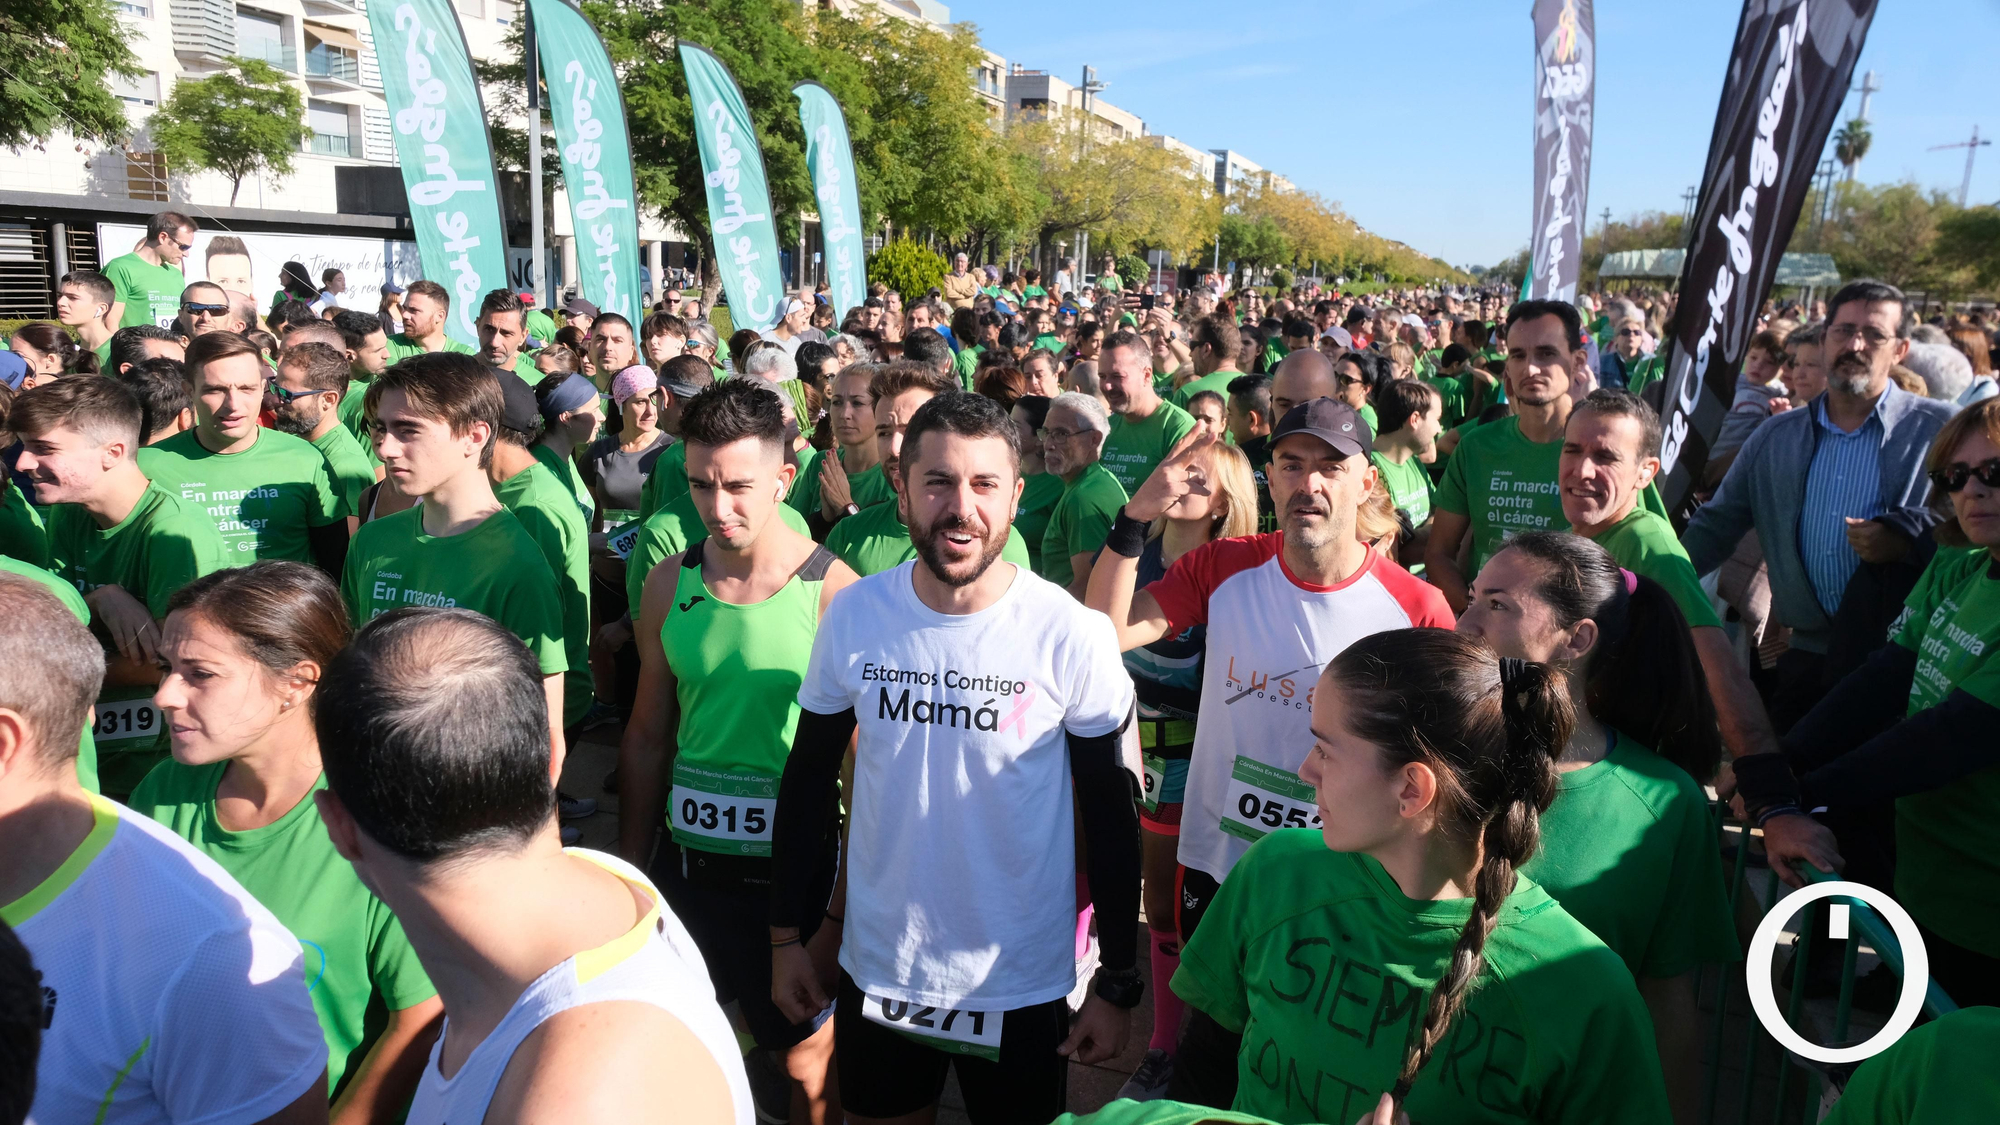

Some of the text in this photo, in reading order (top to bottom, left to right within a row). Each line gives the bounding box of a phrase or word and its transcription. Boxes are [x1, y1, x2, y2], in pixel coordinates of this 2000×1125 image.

[357, 252, 371, 270] de
[375, 252, 403, 273] hacer
[1660, 410, 1689, 476] El
[1680, 264, 1735, 416] Corte
[1103, 451, 1148, 463] En marcha
[181, 487, 279, 502] En marcha
[1489, 477, 1560, 495] En march
[207, 504, 243, 517] ntra
[1488, 494, 1533, 509] contra
[217, 518, 269, 532] áncer
[1487, 509, 1500, 522] el
[373, 581, 397, 601] En
[1921, 634, 1951, 662] ontra
[861, 663, 1026, 696] Estamos Contigo
[878, 687, 999, 732] Mamá
[676, 763, 696, 774] Córdoba
[702, 770, 723, 779] Marcha
[723, 773, 743, 781] Contra
[1238, 759, 1264, 774] Córdoba
[1264, 768, 1273, 777] En
[1273, 772, 1296, 784] Marcha
[682, 798, 767, 834] 0315
